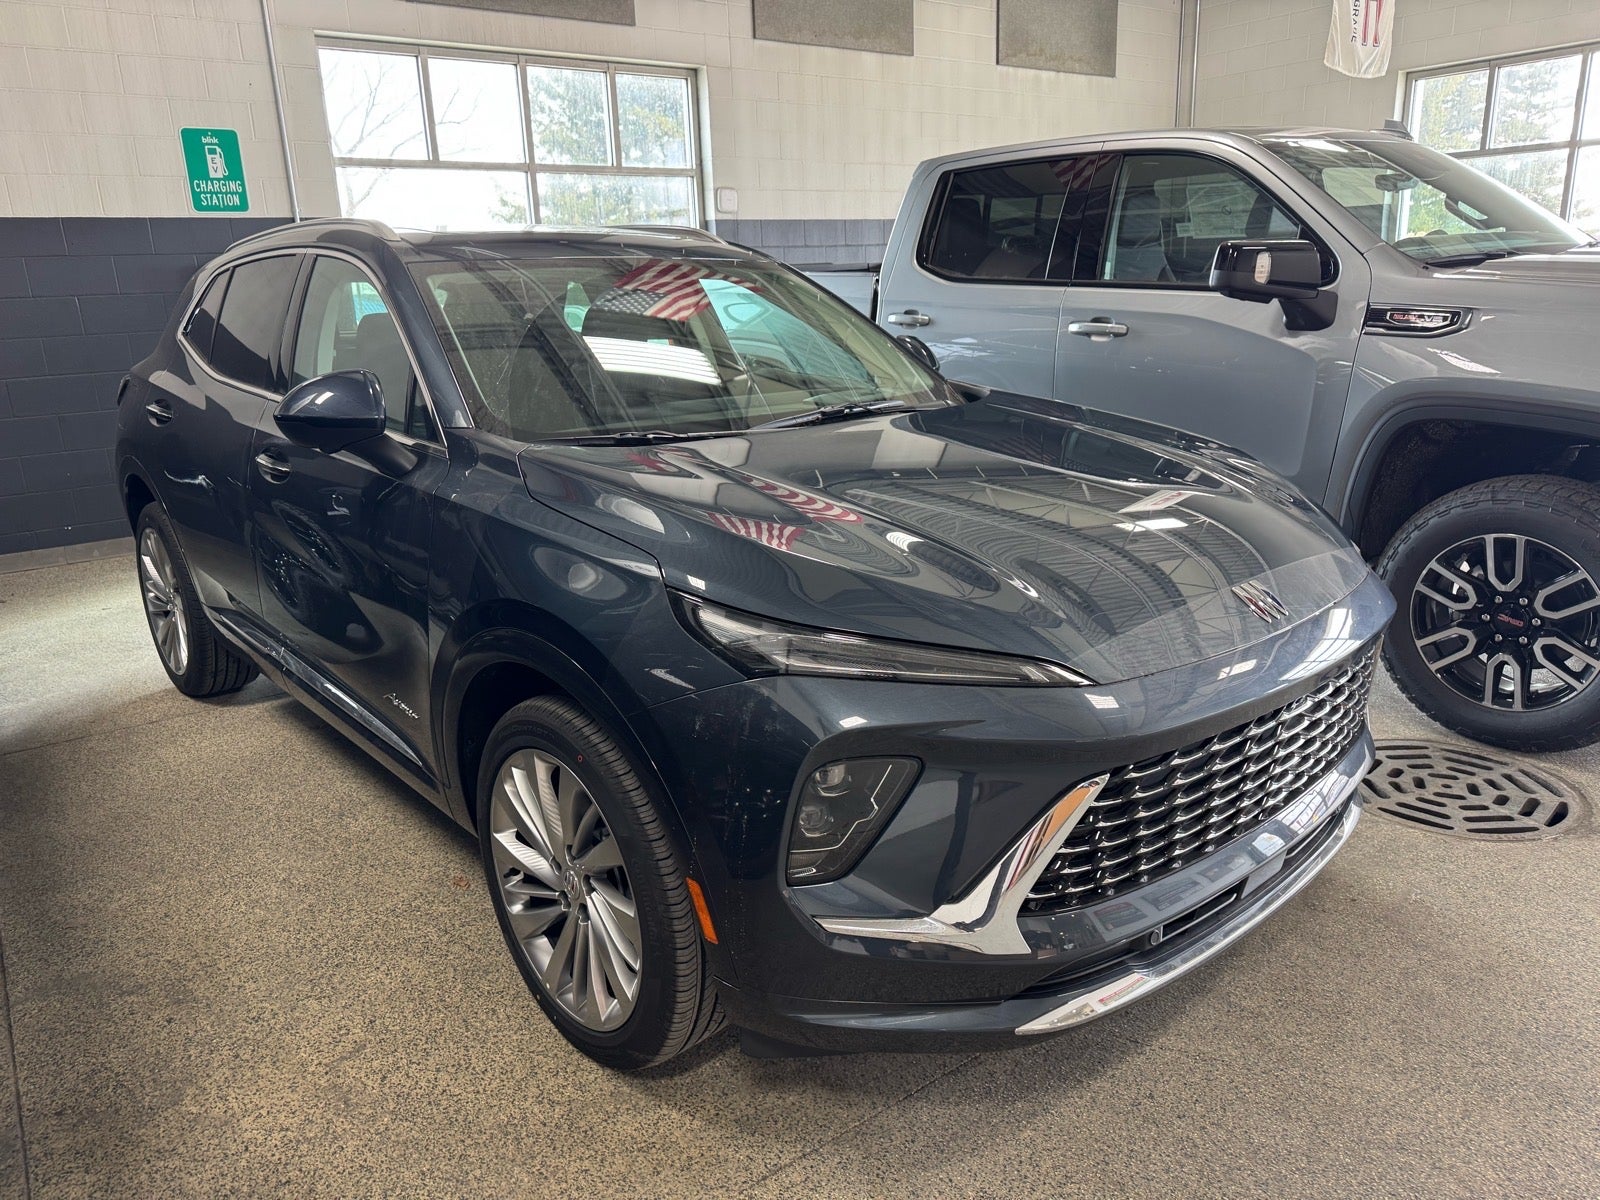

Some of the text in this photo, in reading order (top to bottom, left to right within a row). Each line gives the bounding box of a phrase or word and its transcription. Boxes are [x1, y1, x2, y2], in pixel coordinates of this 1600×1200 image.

[201, 132, 219, 143] blink
[193, 179, 242, 192] CHARGING
[201, 194, 240, 206] STATION
